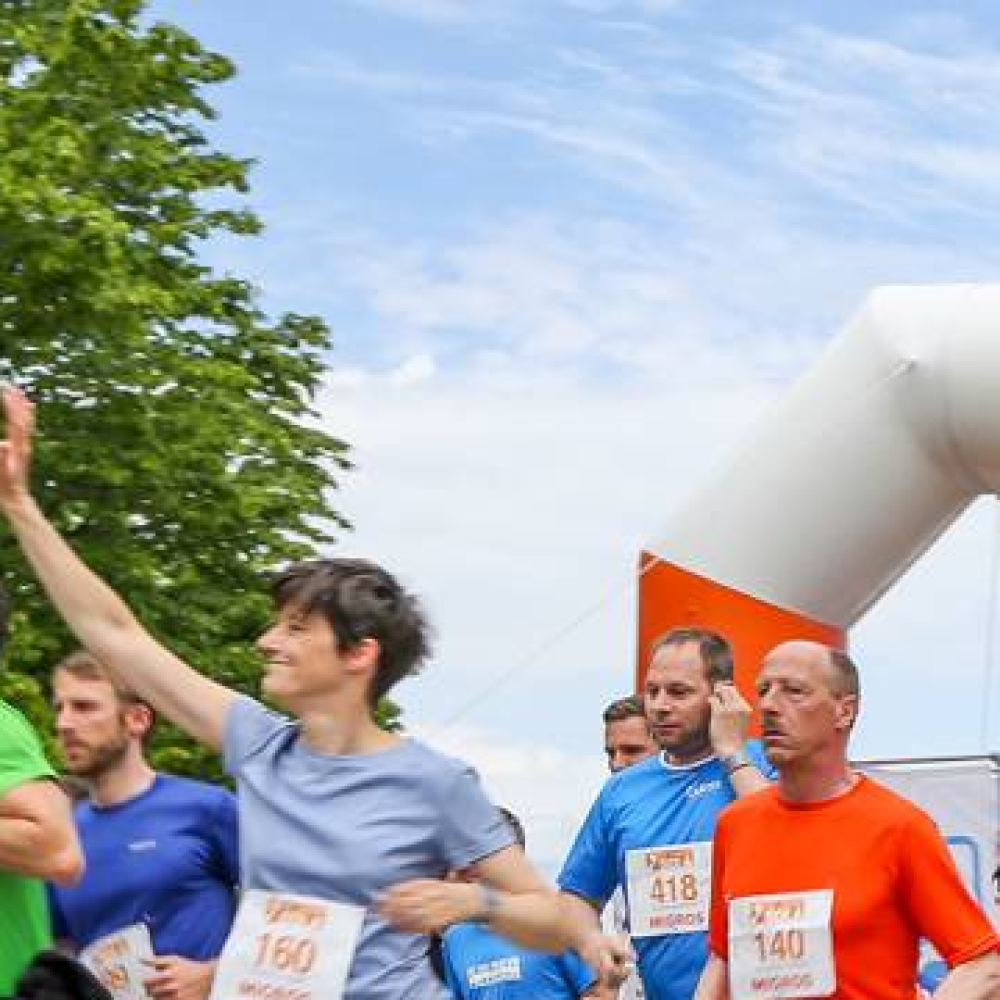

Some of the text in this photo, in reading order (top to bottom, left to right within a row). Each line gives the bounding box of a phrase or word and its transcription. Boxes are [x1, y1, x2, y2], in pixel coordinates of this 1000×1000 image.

[650, 875, 698, 902] 418
[256, 933, 317, 973] 160
[755, 930, 804, 961] 140
